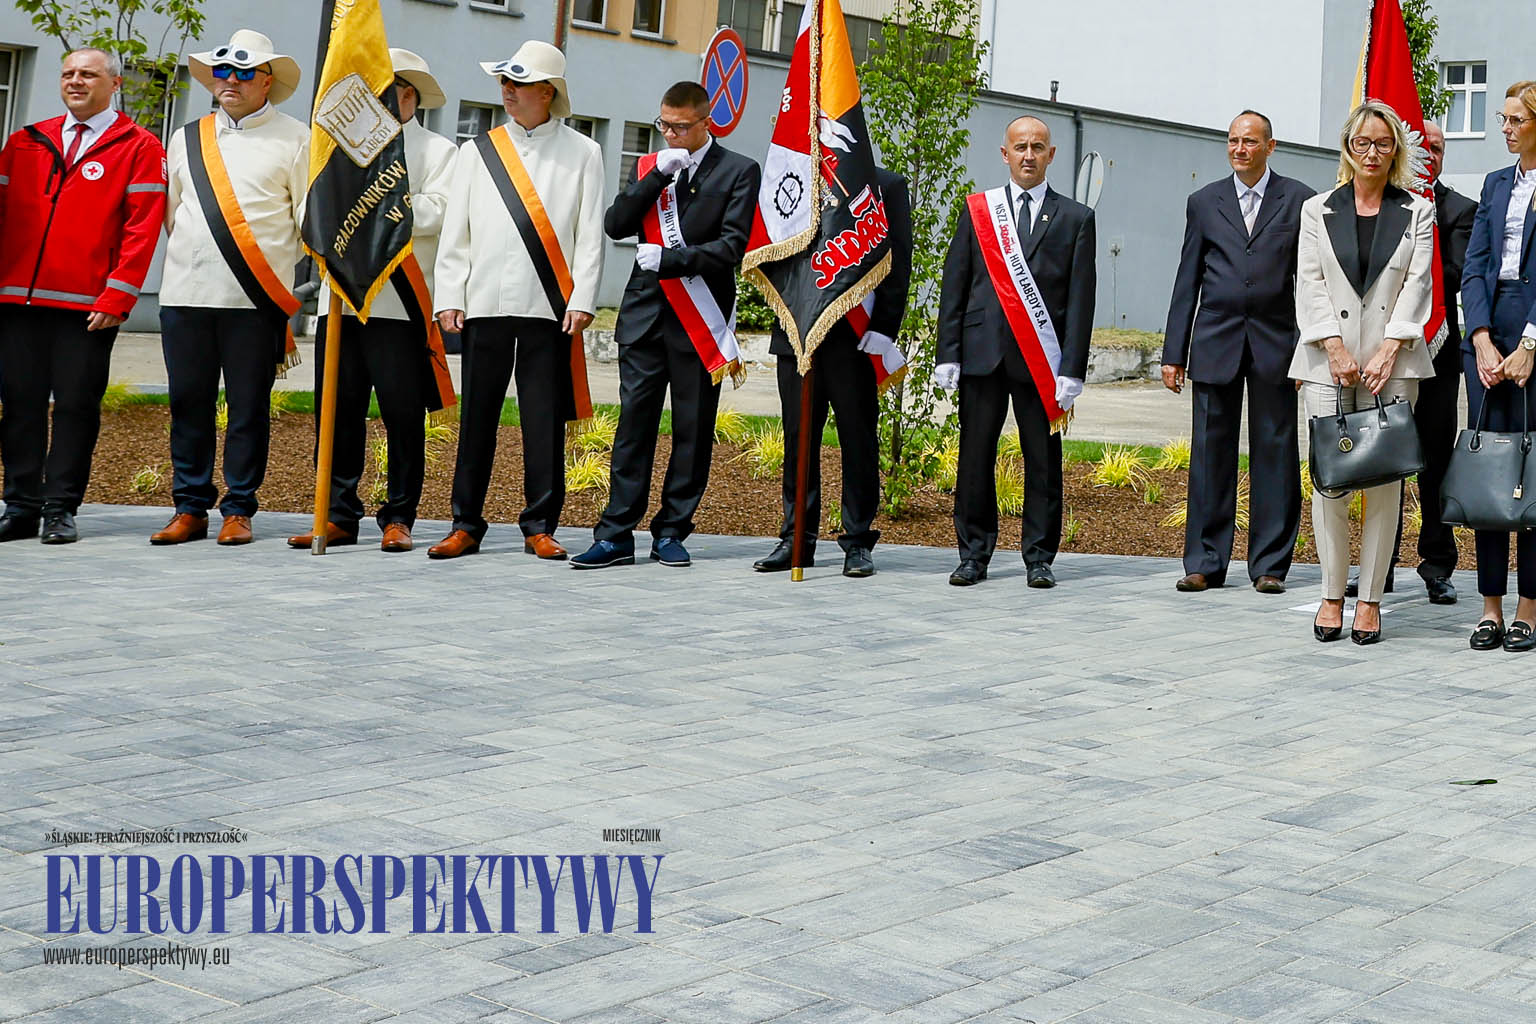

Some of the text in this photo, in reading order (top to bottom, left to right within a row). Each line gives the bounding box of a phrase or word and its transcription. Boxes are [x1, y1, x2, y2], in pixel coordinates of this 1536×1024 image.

[782, 87, 791, 113] BÓG
[333, 159, 407, 258] PRACOWNIKÓW
[385, 192, 412, 223] W G
[663, 210, 676, 232] HUTY
[994, 203, 1008, 223] NSZZ
[1010, 254, 1026, 277] HUTY
[1019, 277, 1040, 310] ŁABĘDY
[1034, 310, 1048, 329] S.A.
